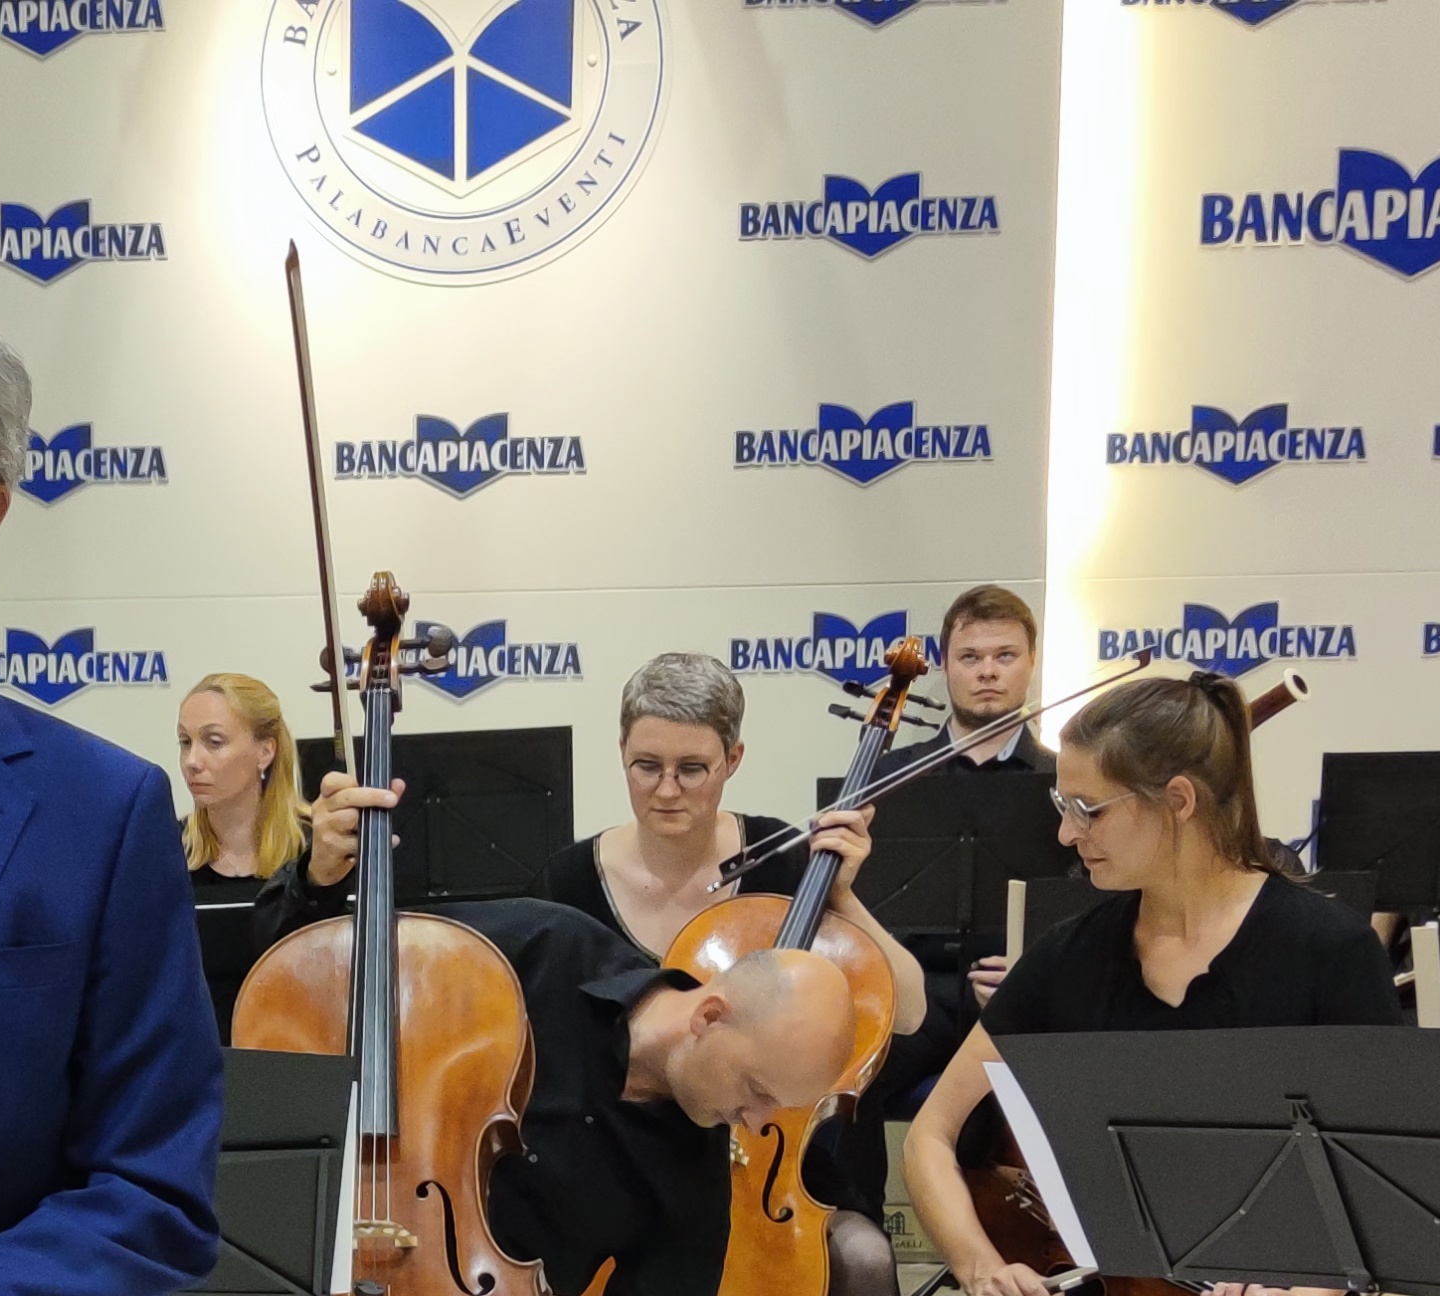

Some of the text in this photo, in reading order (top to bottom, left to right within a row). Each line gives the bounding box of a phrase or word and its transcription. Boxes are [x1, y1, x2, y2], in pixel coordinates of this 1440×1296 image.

[740, 197, 999, 236] BANCAPIACENZA
[335, 436, 584, 474] BANCAPIACENZA
[735, 425, 991, 463] BANCAPIACENZA
[1107, 427, 1365, 463] BANCAPIACENZA
[23, 447, 166, 480] PIACENZA
